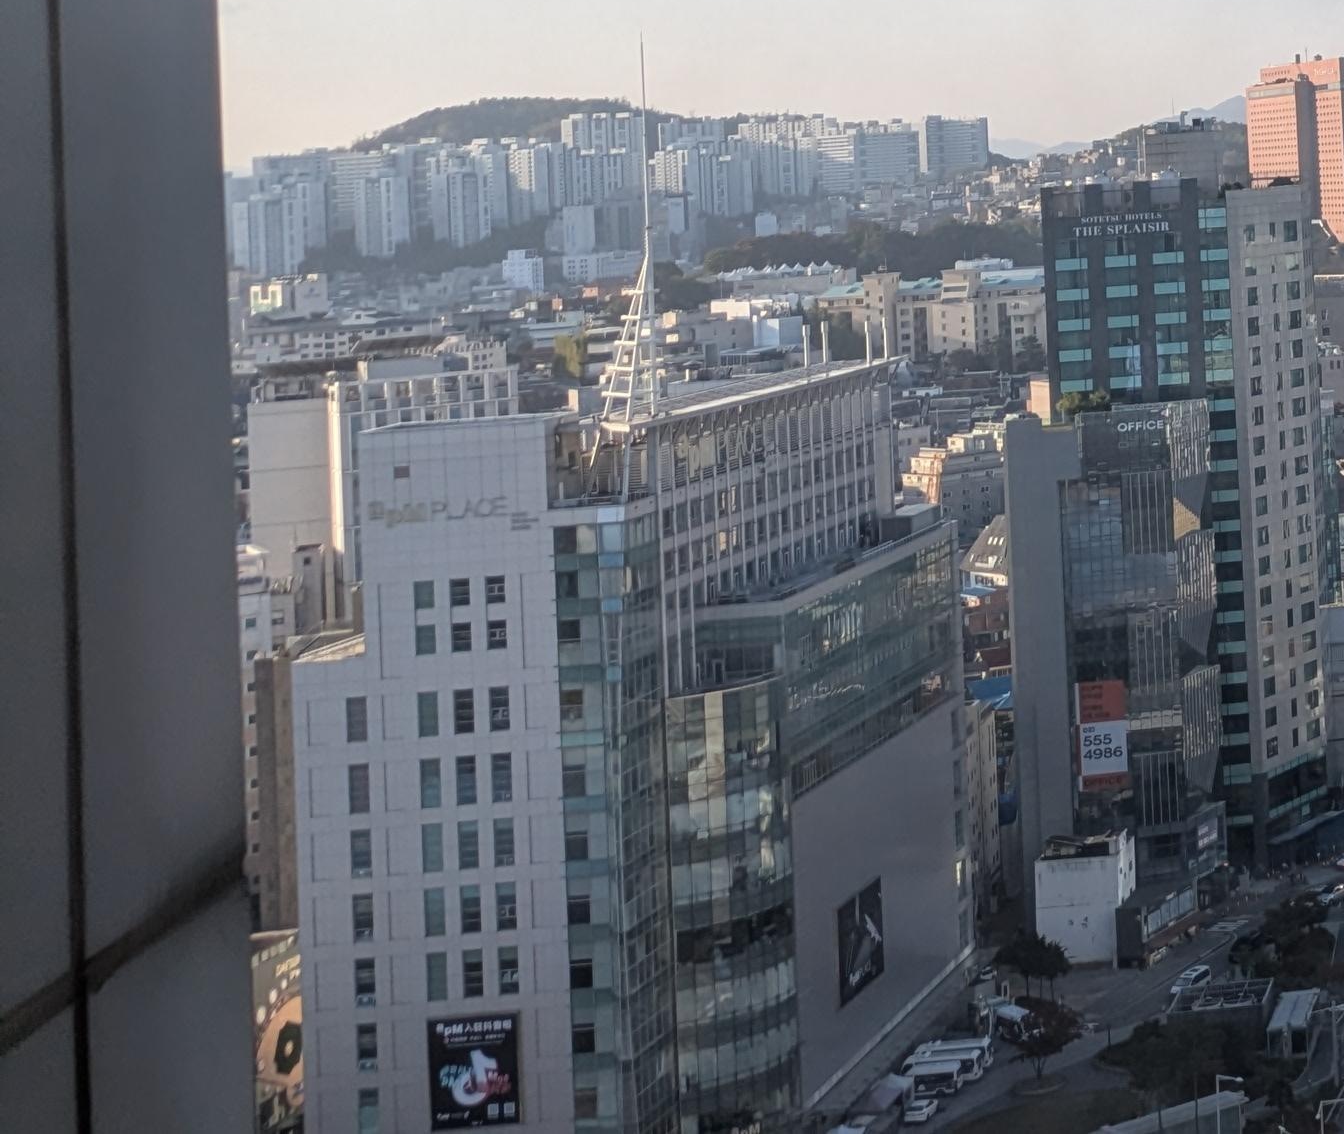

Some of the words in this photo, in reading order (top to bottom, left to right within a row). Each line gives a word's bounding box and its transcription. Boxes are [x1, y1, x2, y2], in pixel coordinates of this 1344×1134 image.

[1081, 215, 1122, 225] SOTETSU
[1125, 212, 1162, 221] HOTELS
[1073, 225, 1102, 237] THE
[1107, 221, 1170, 235] SPLAISIR
[1117, 419, 1164, 432] OFFICE
[1082, 733, 1113, 747] 555
[1082, 746, 1124, 761] 4986
